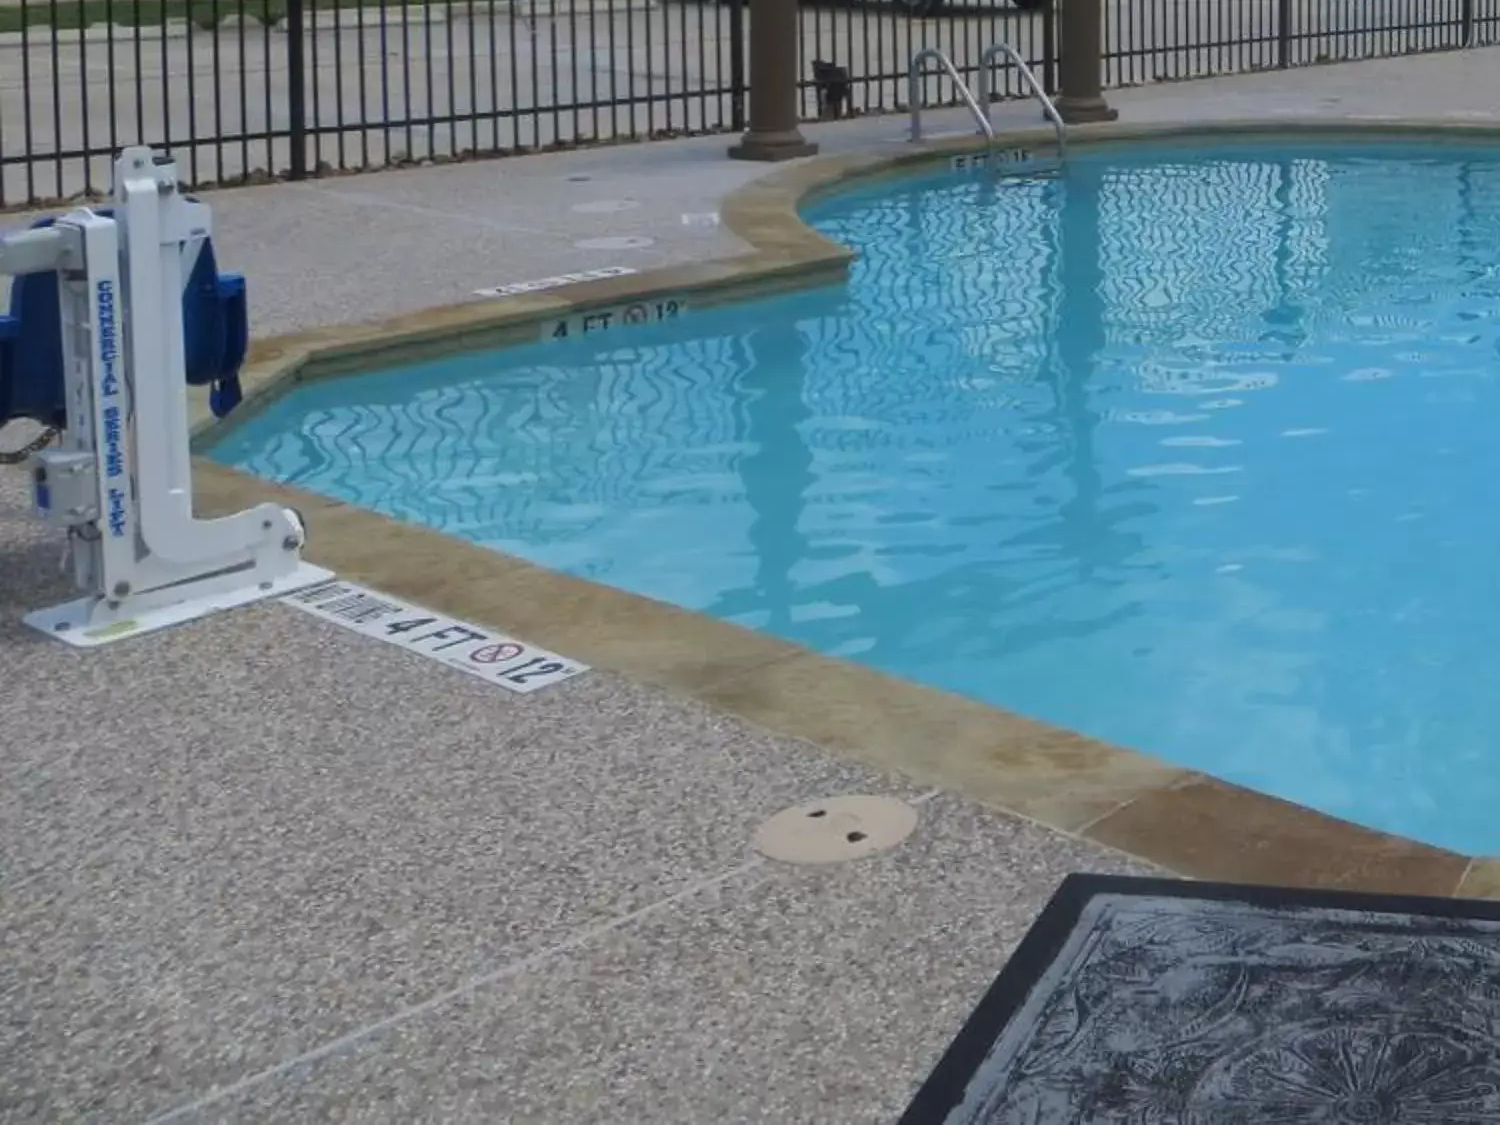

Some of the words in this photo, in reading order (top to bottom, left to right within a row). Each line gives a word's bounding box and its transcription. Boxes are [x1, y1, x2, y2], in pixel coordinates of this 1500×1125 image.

[386, 617, 435, 636] 4
[411, 626, 487, 652] FT
[499, 657, 562, 683] 12
